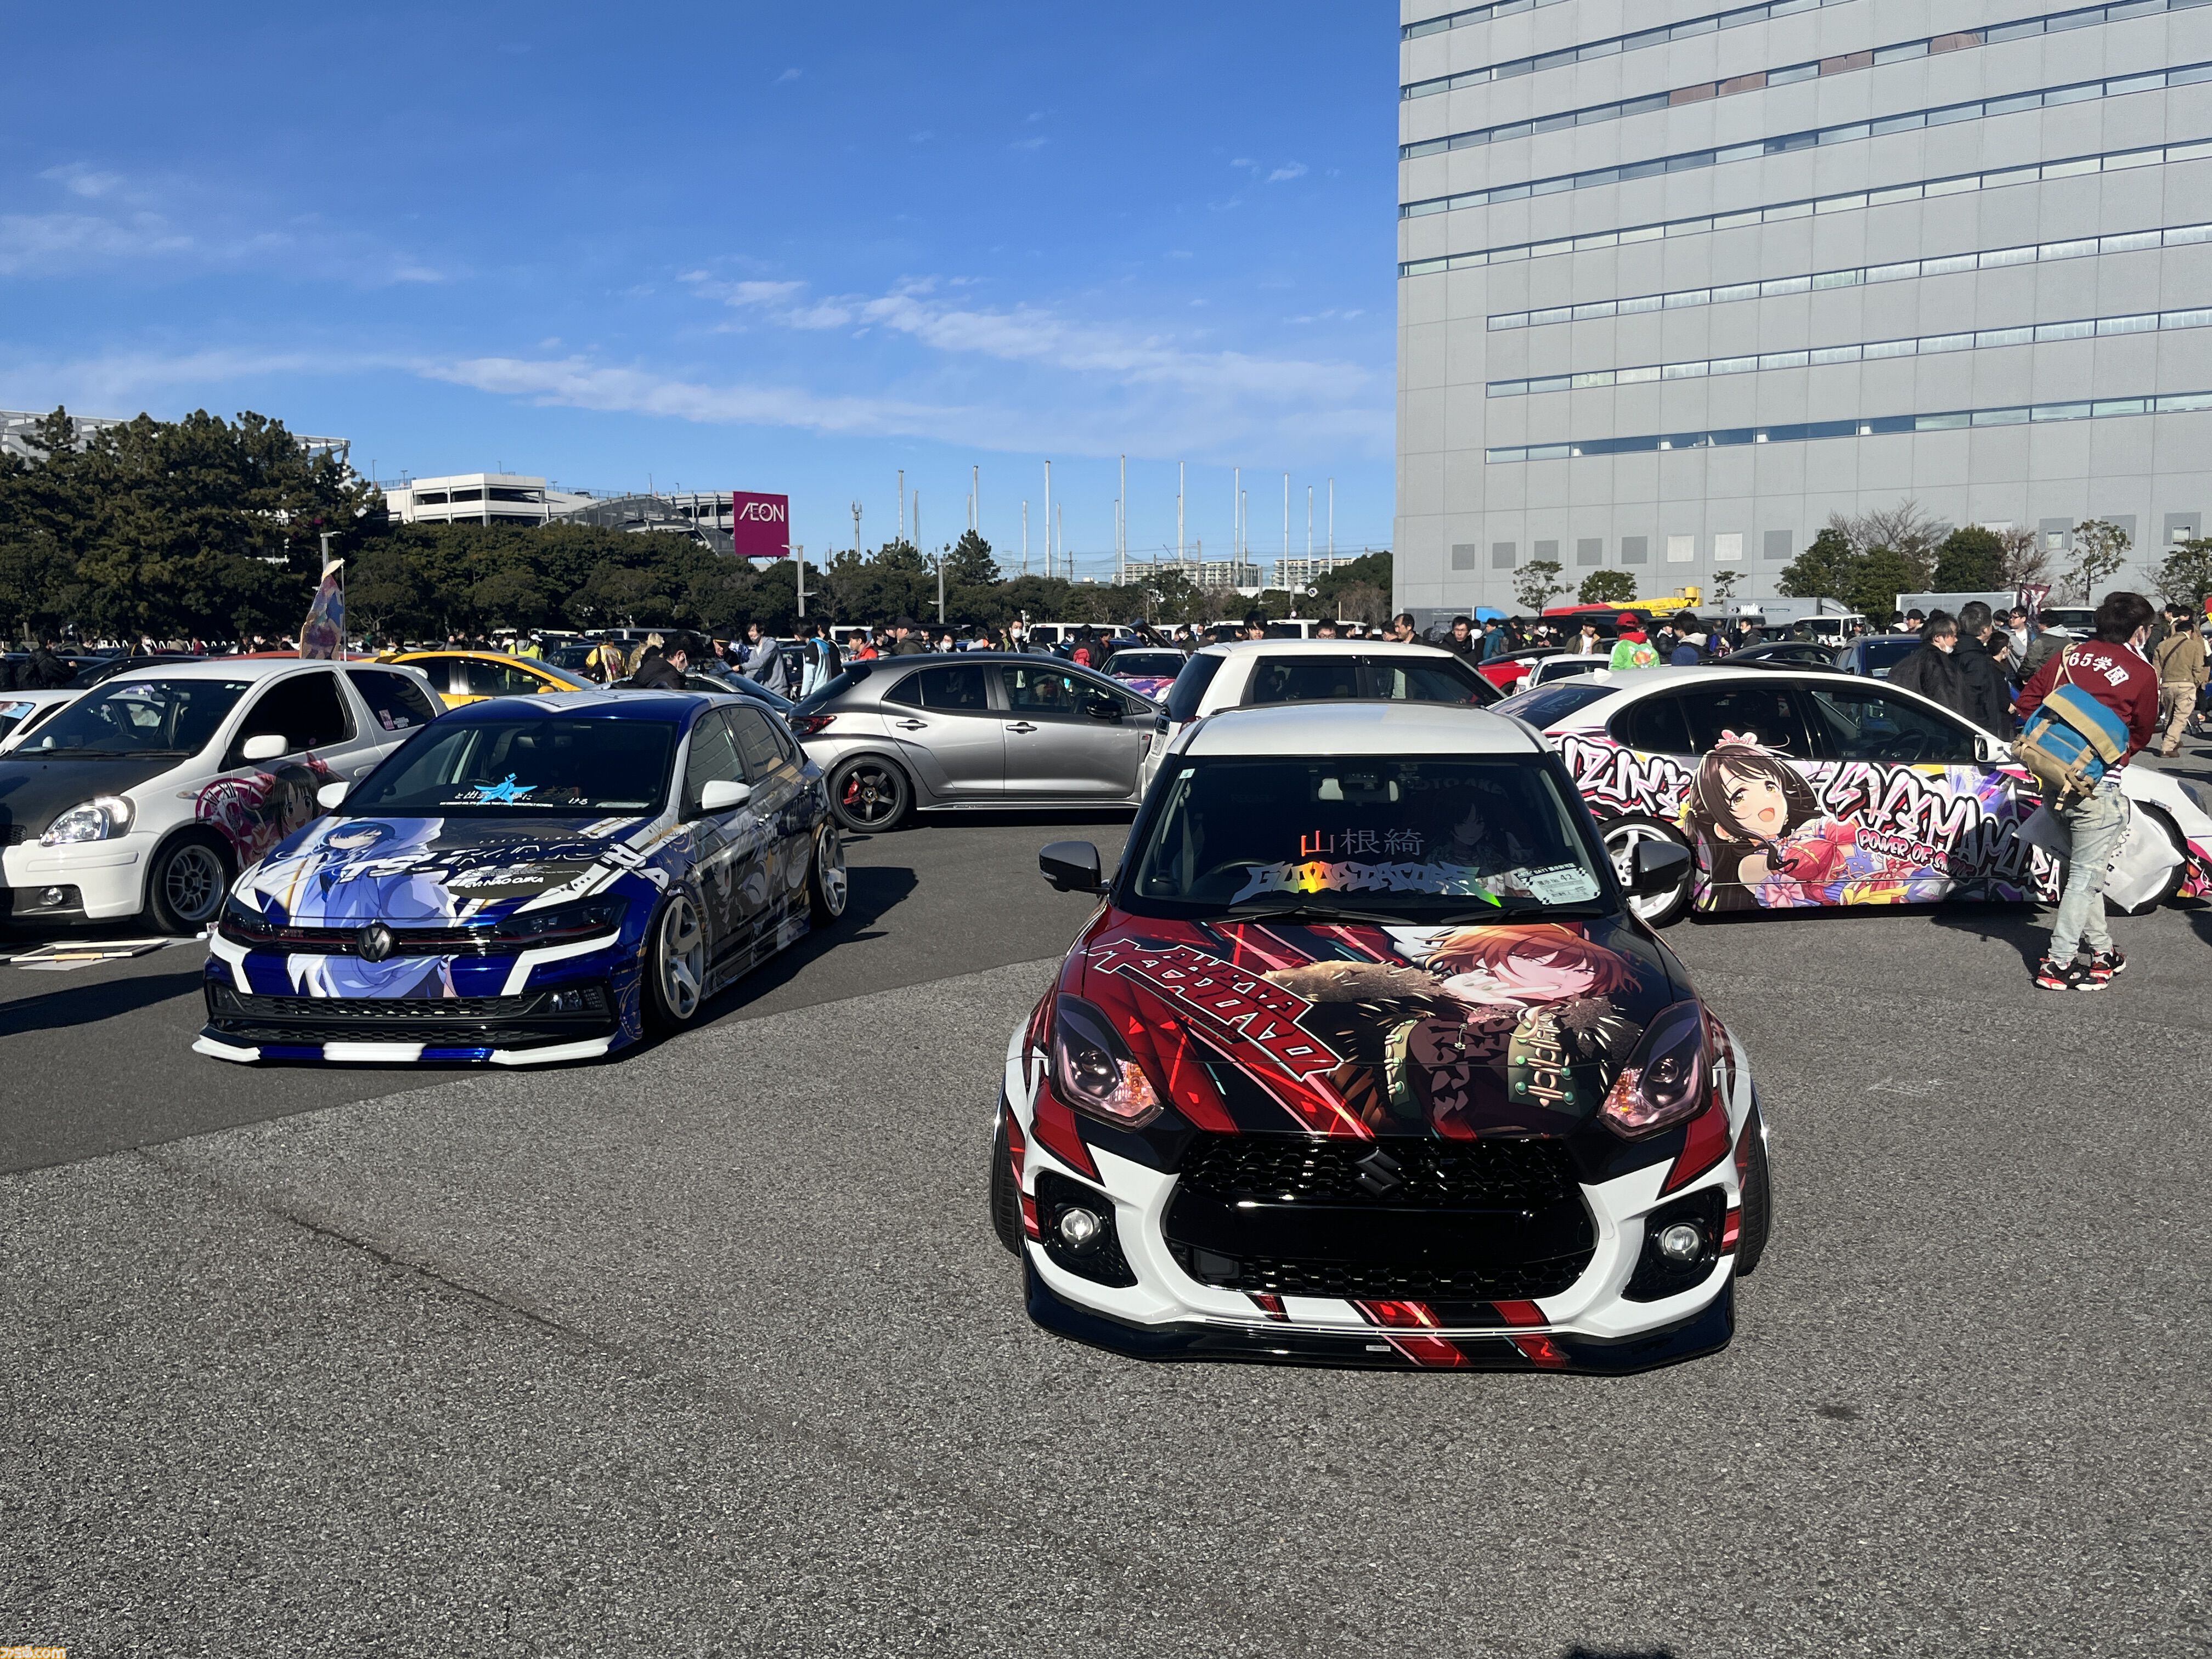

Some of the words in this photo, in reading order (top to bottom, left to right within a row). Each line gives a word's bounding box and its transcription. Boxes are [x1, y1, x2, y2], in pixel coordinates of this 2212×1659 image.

[2068, 652, 2129, 687] 65学園
[1301, 828, 1425, 856] 山根綺
[1858, 829, 1909, 856] POWER
[1911, 845, 1934, 865] OF
[485, 878, 511, 887] NAO
